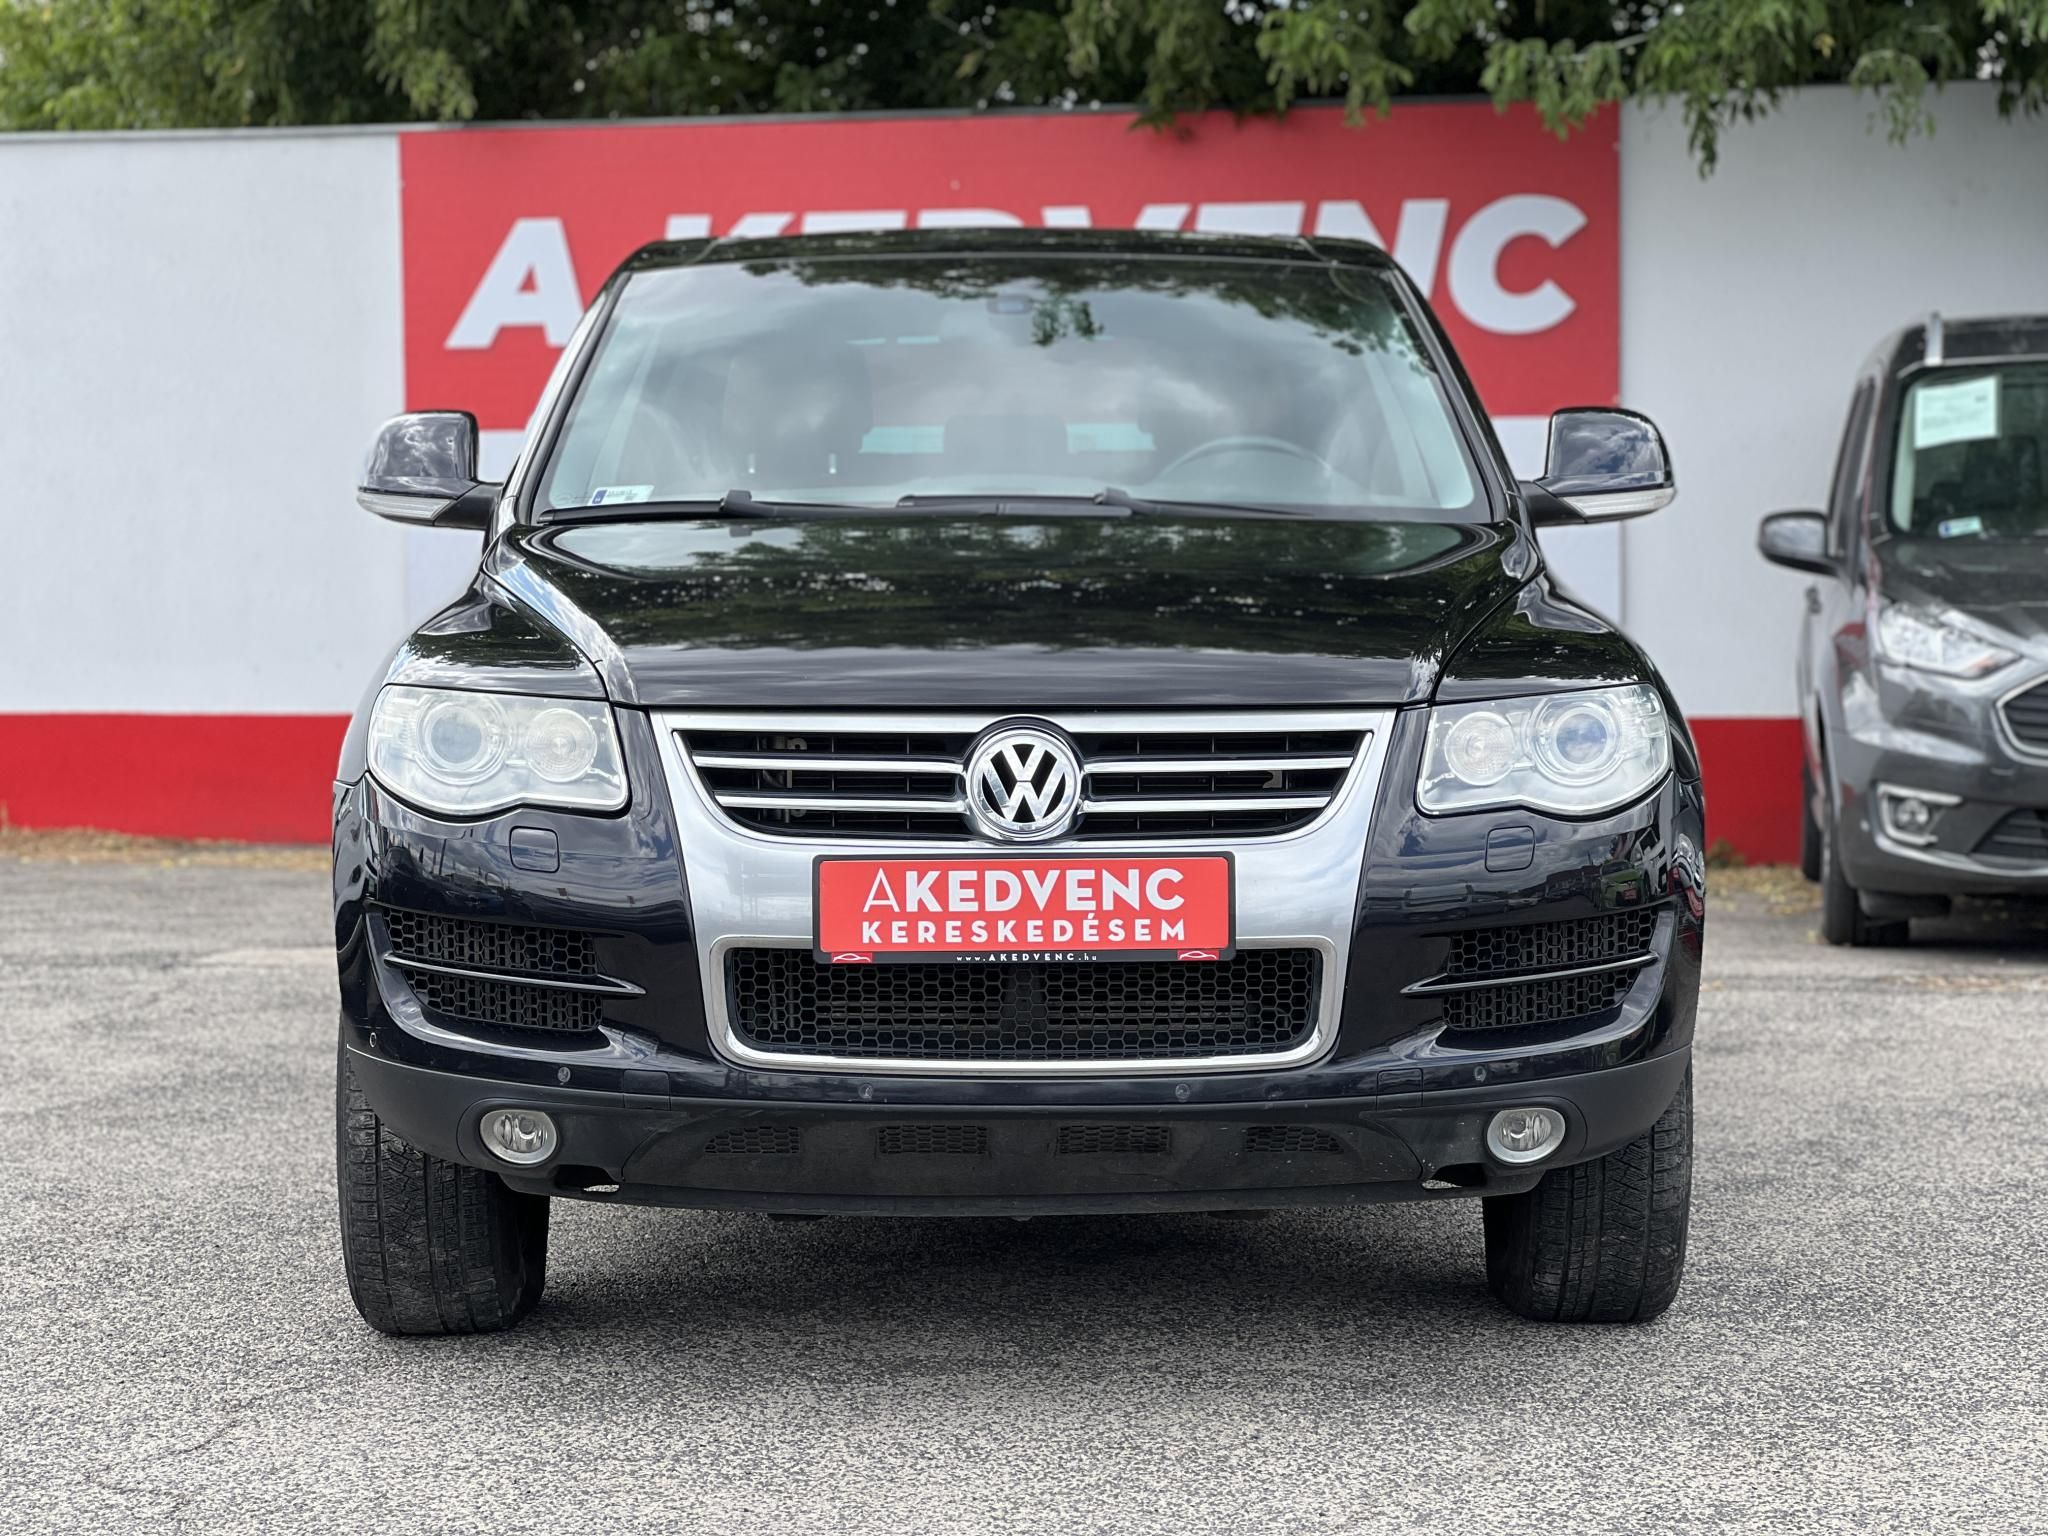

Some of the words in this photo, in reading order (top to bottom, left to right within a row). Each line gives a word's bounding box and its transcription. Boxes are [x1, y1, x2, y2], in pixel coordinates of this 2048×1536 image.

[977, 739, 1073, 829] VW
[862, 913, 1185, 944] KERESKEDÉSEM
[956, 952, 1097, 962] www.AKEDVENC.hu
